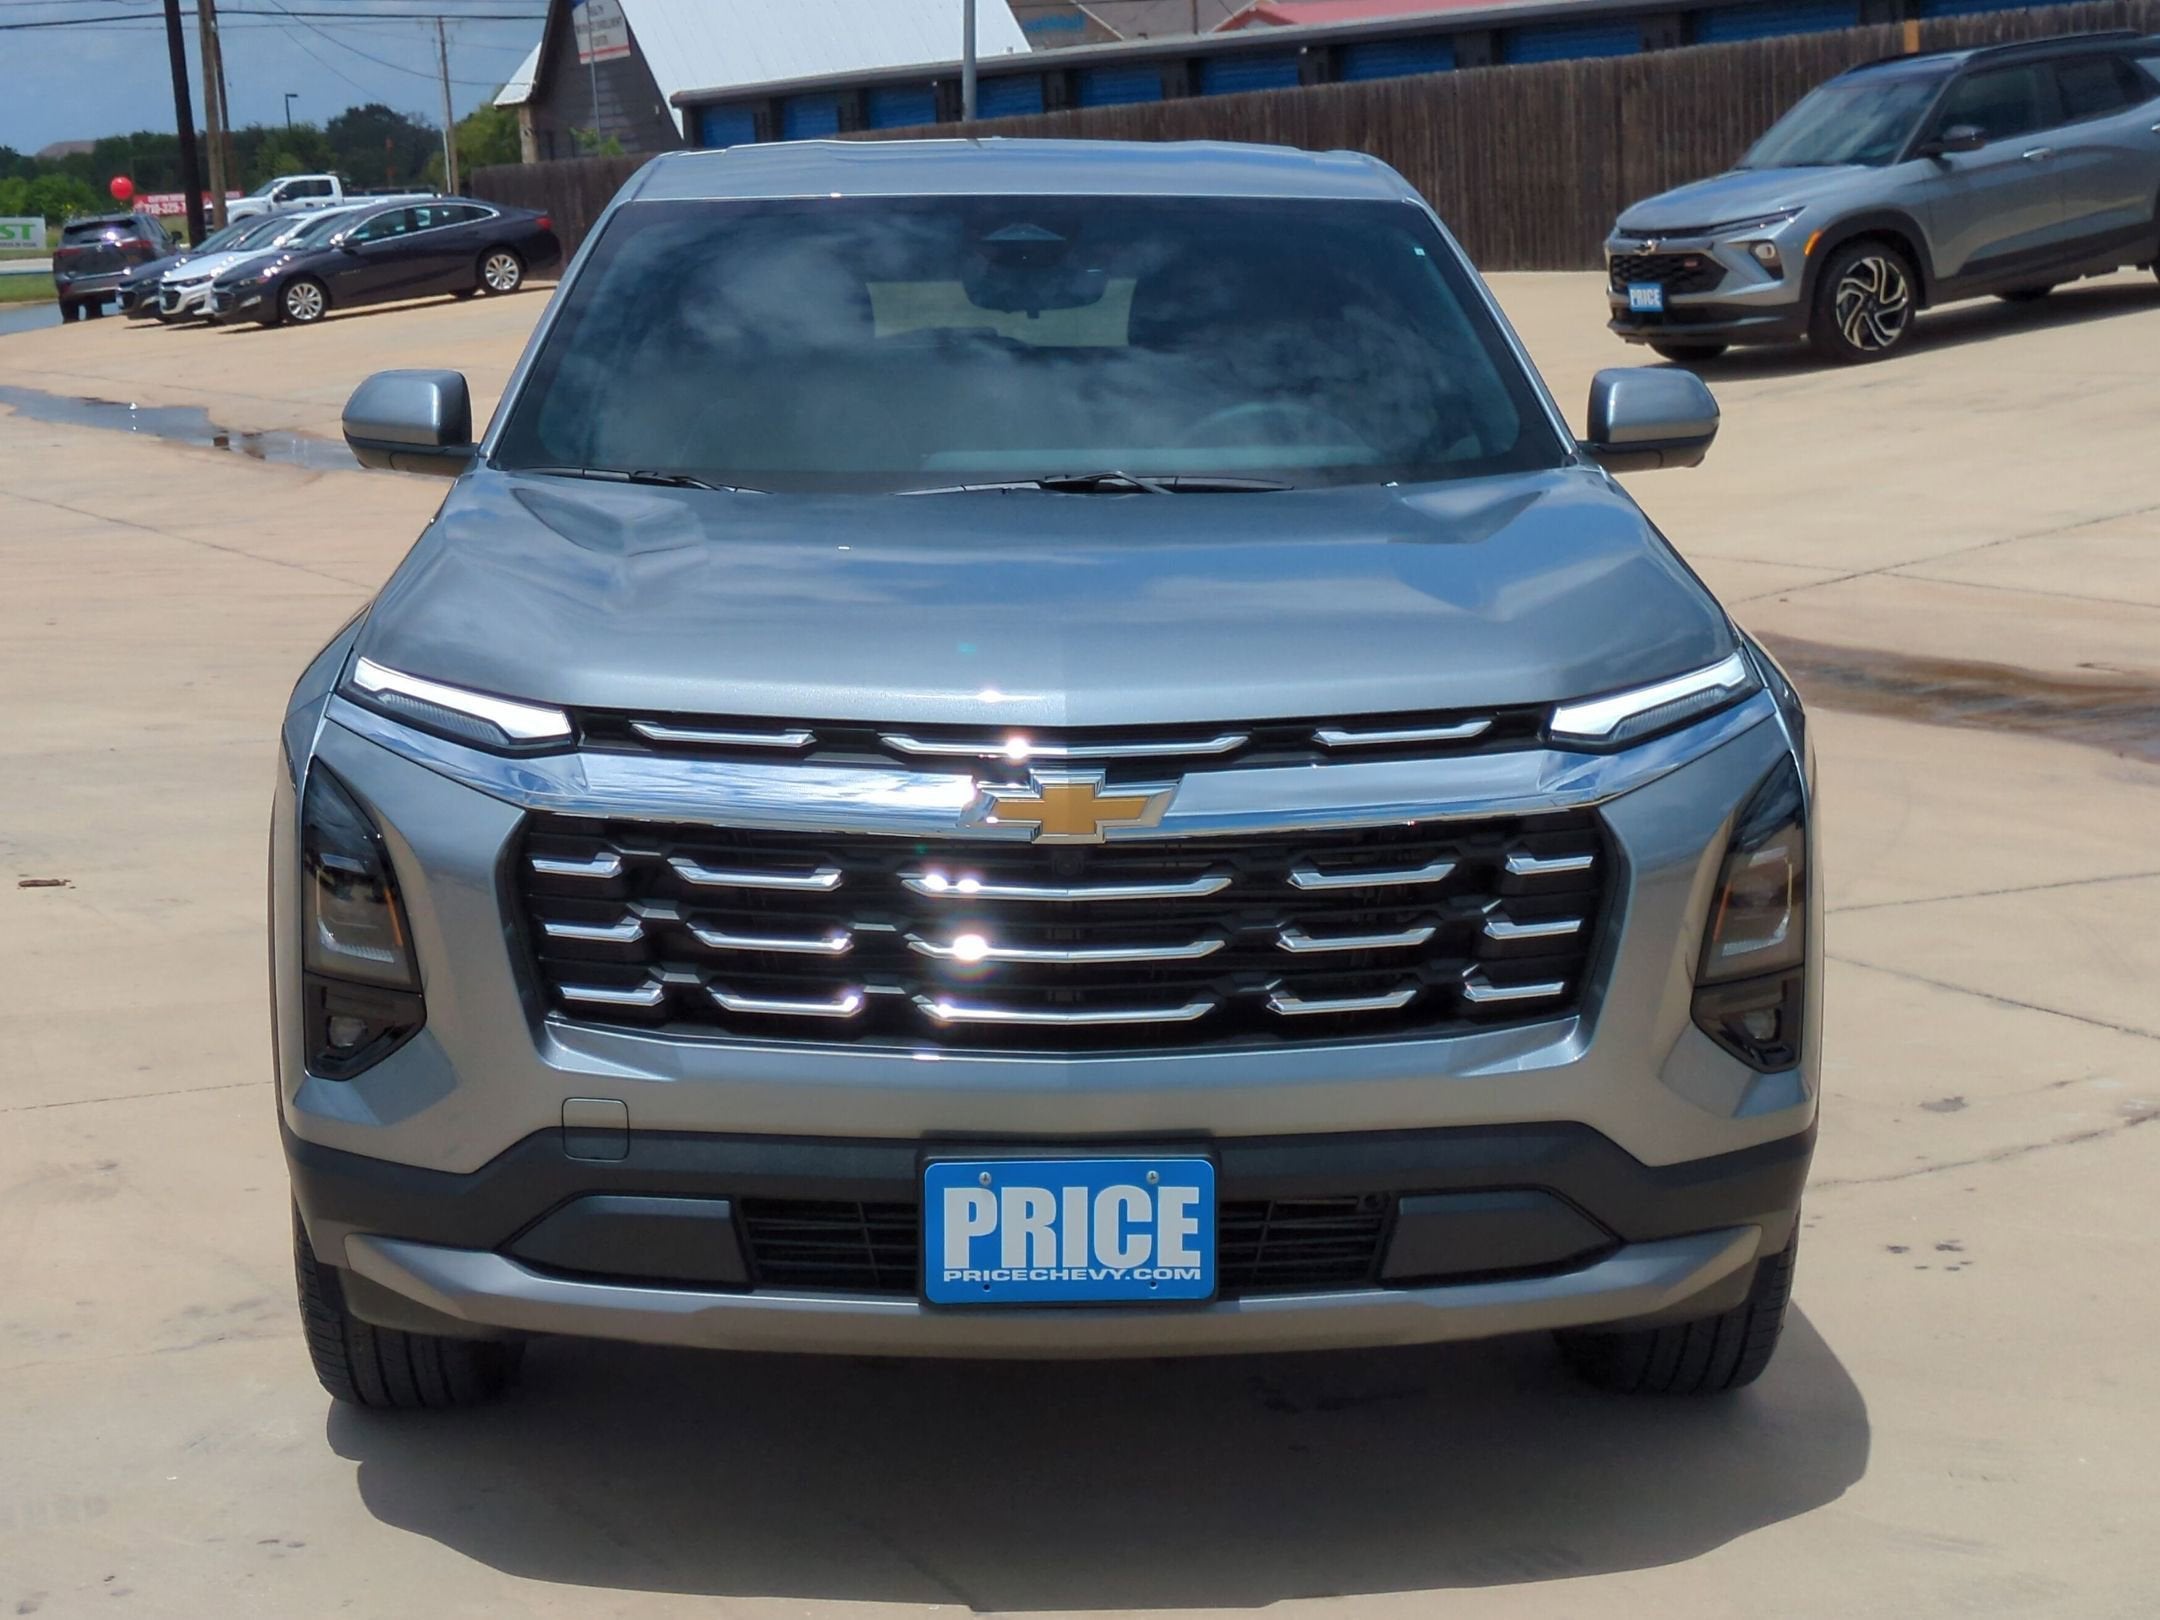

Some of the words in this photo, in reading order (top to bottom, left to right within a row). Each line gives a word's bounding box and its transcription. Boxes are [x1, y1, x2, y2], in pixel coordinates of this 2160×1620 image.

[1630, 288, 1662, 307] PRICE
[943, 1185, 1201, 1269] PRICE
[943, 1268, 1201, 1283] PRICECHEVY.COM
